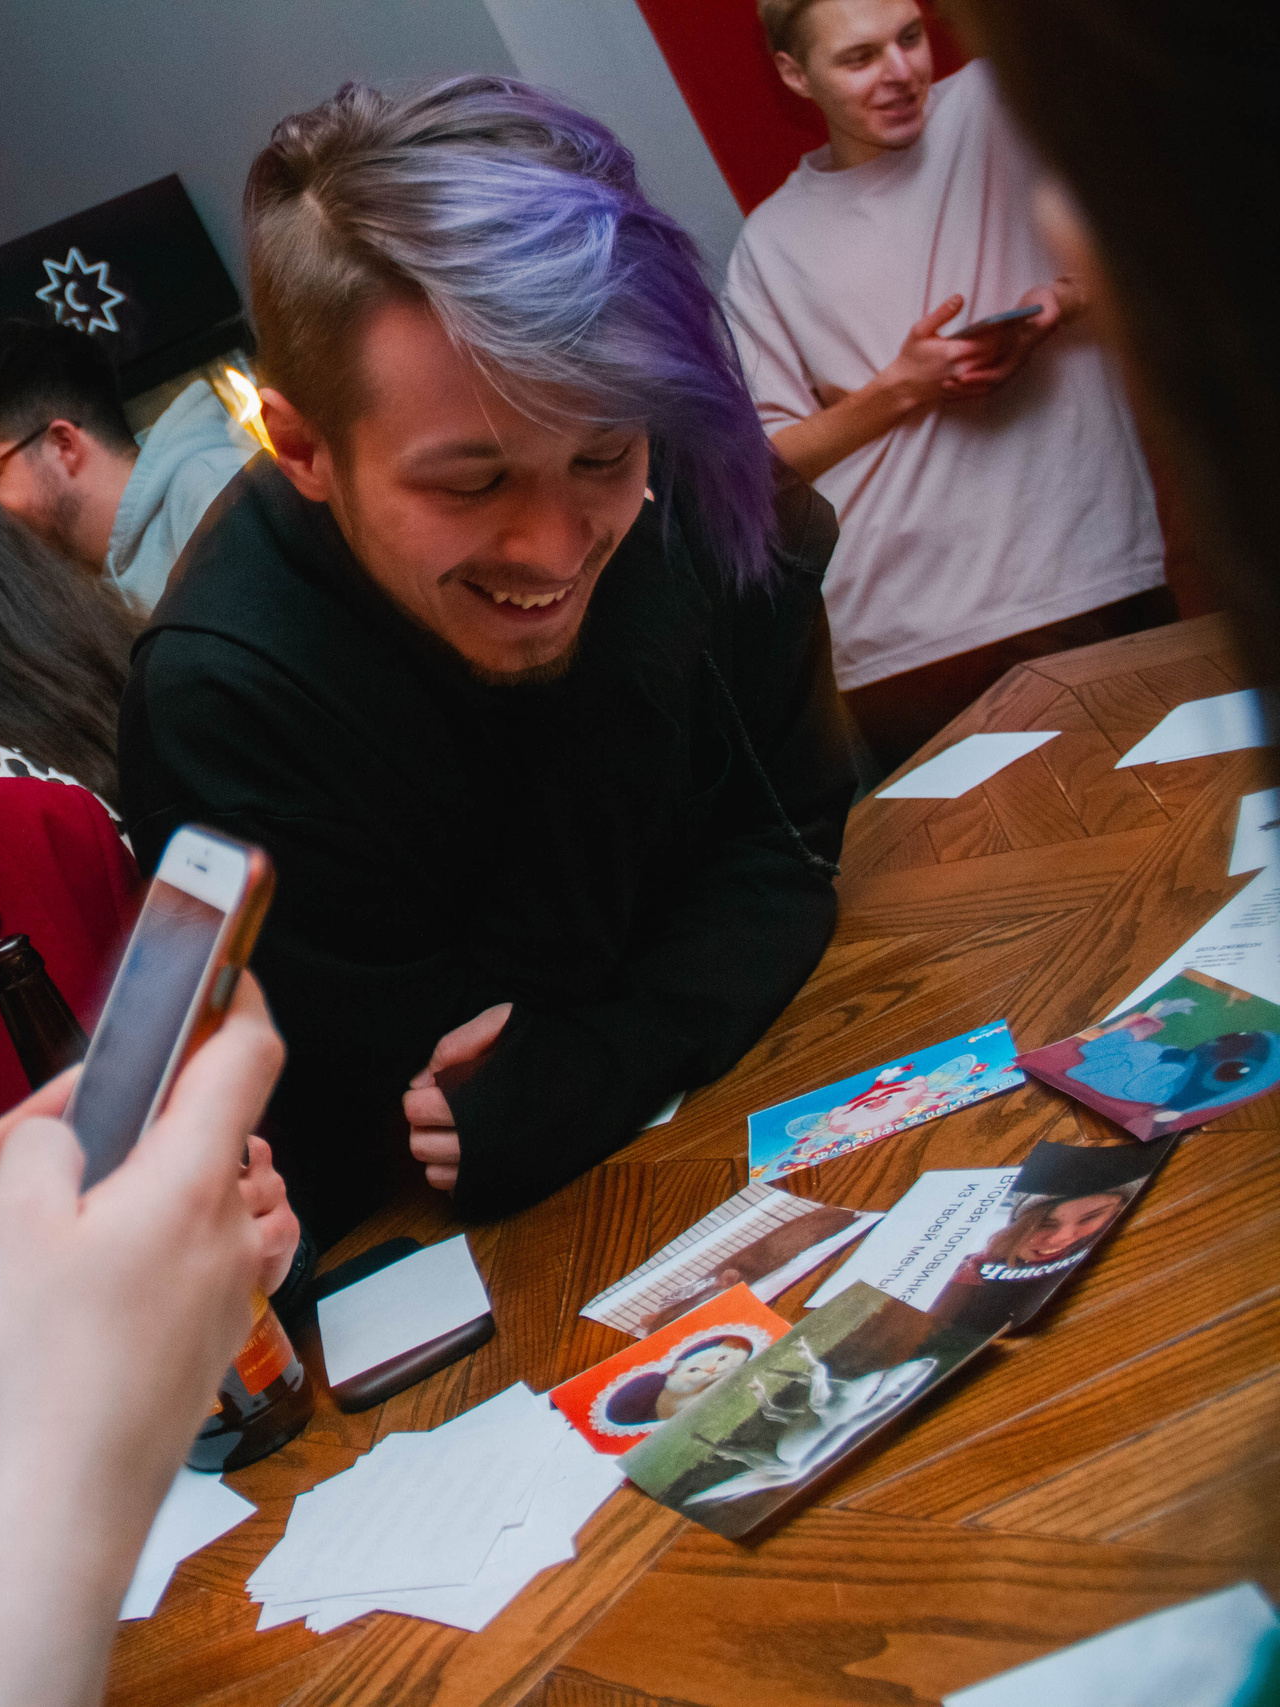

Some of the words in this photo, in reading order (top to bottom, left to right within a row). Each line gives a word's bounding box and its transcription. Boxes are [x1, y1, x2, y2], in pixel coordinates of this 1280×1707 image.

[881, 1116, 919, 1136] ФЕЯ
[958, 1183, 980, 1198] из
[964, 1174, 1018, 1223] Вторая
[920, 1201, 964, 1242] твоей
[876, 1246, 925, 1289] мечты
[897, 1227, 971, 1303] половинка
